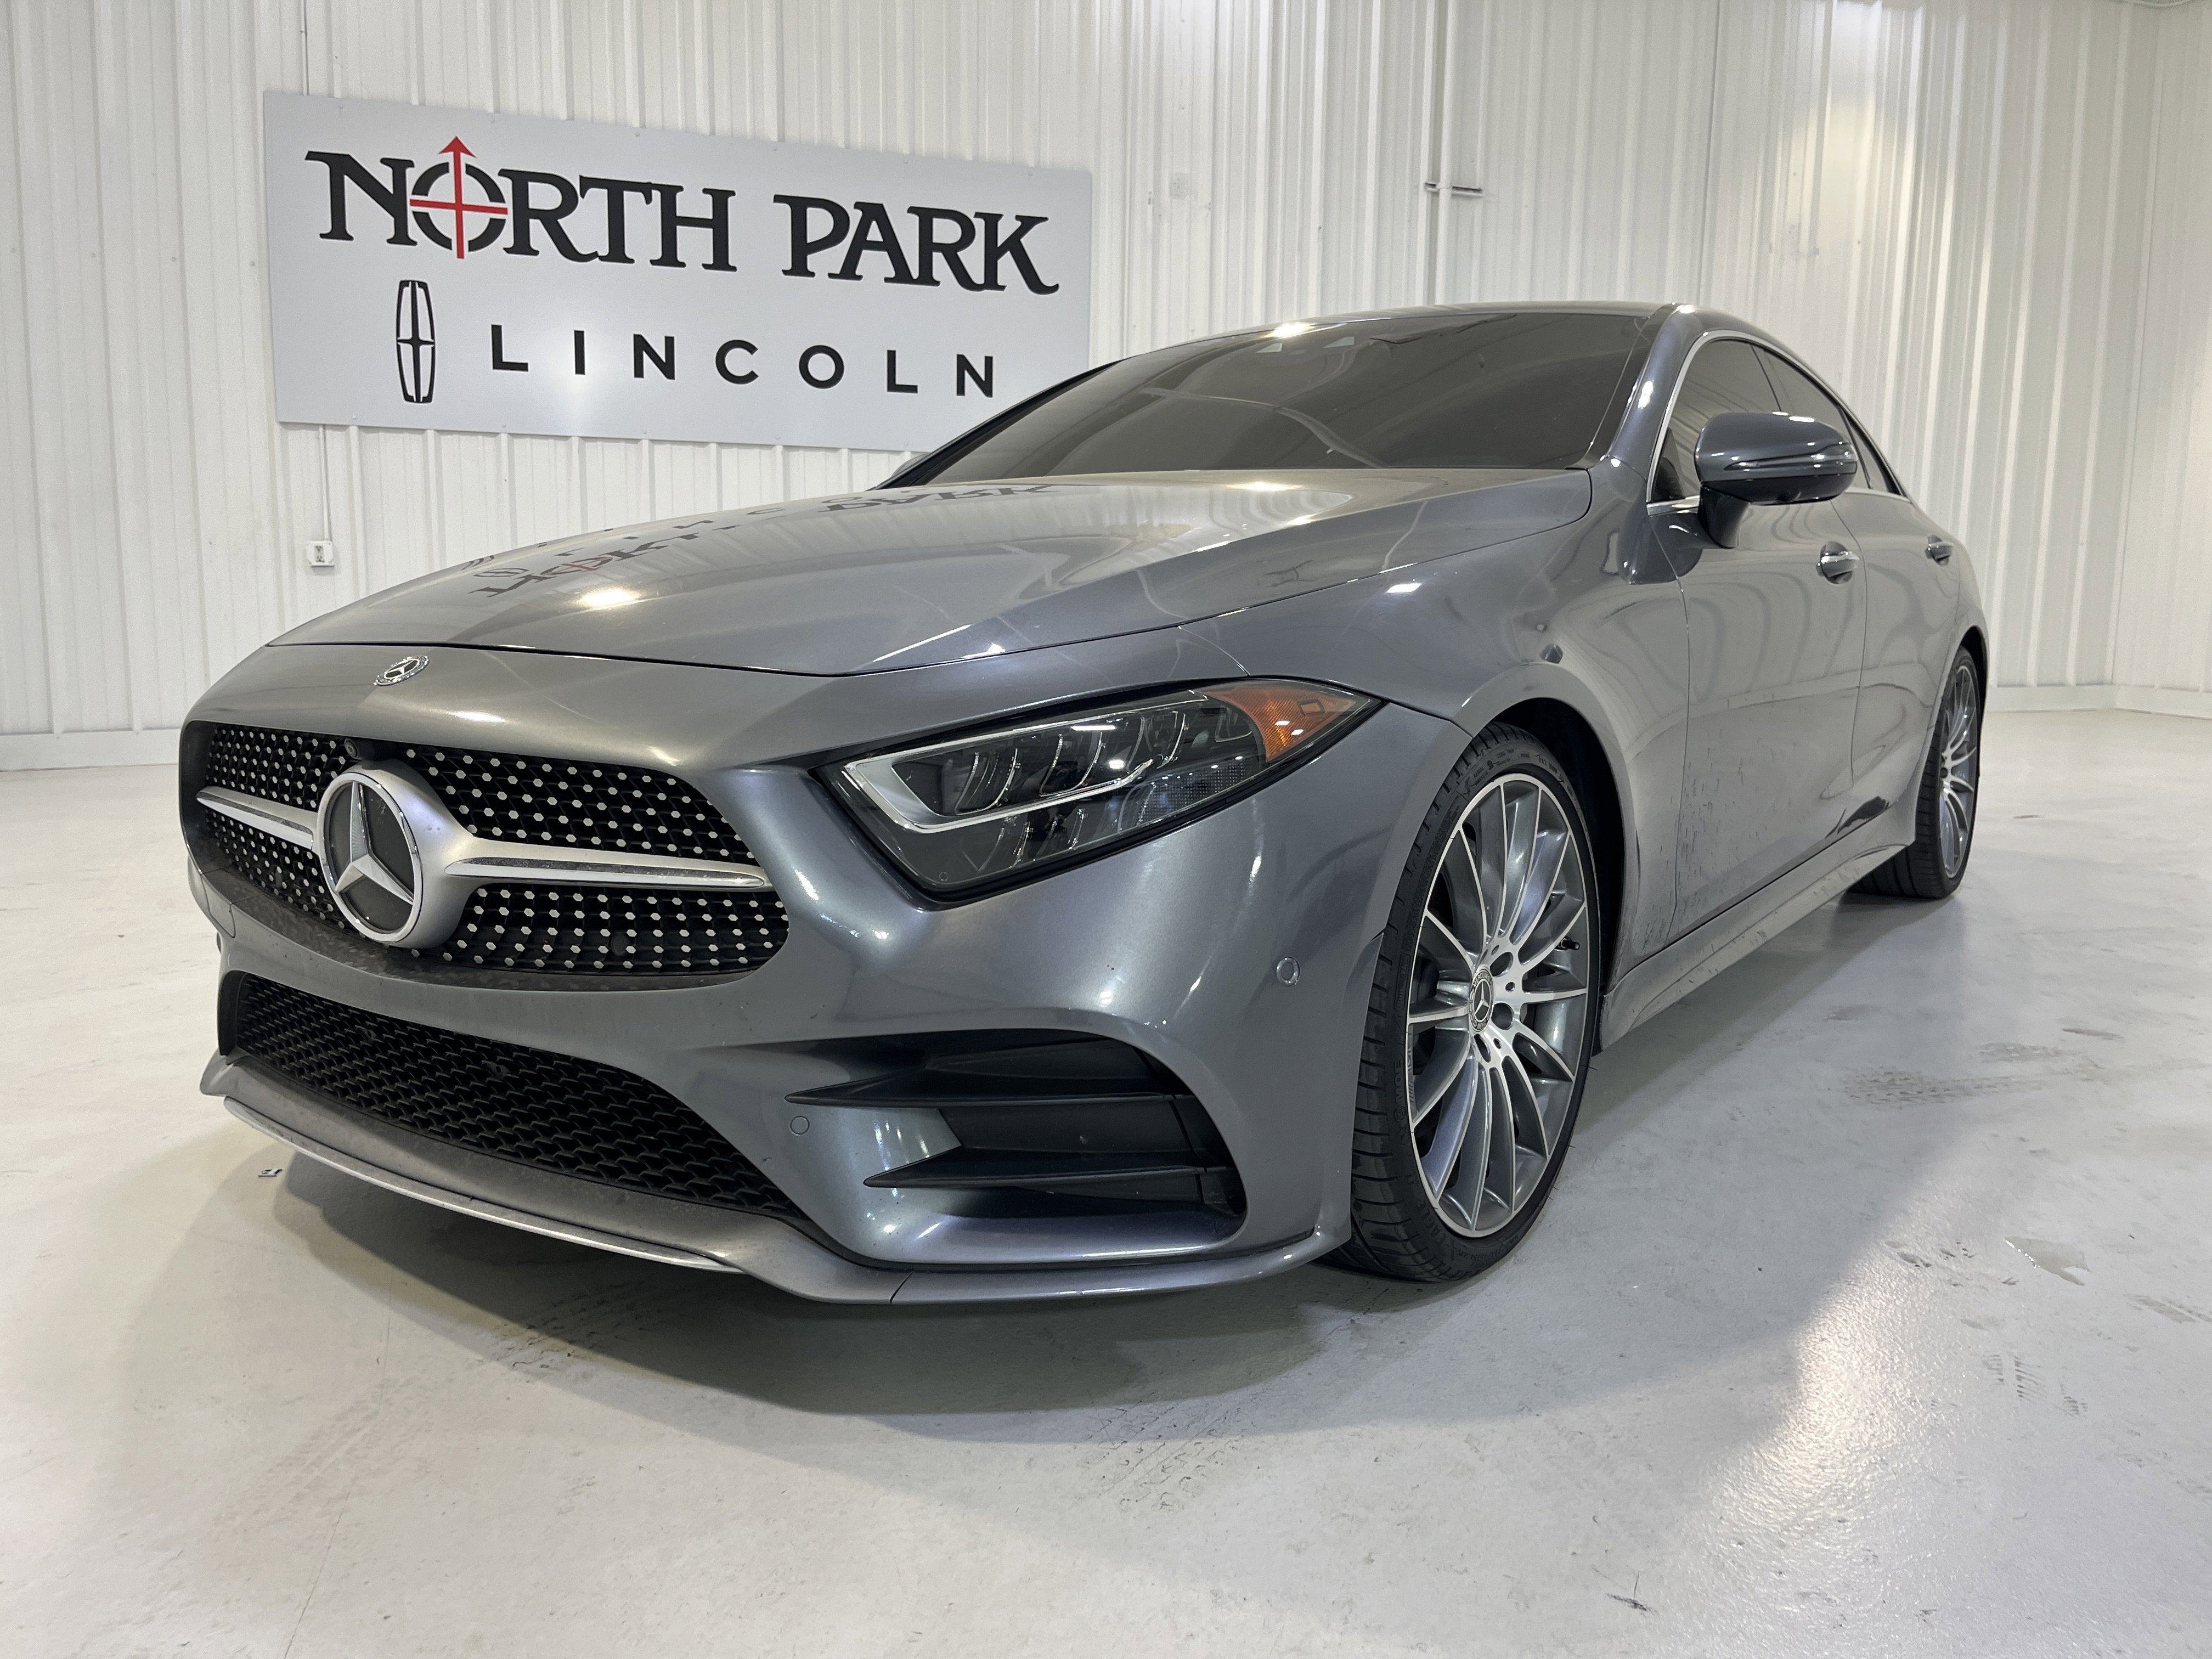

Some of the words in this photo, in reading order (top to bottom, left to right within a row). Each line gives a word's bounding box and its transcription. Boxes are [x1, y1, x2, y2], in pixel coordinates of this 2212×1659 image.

[305, 149, 737, 272] NORTH
[774, 195, 1059, 295] PARK
[491, 324, 993, 397] LINCOLN
